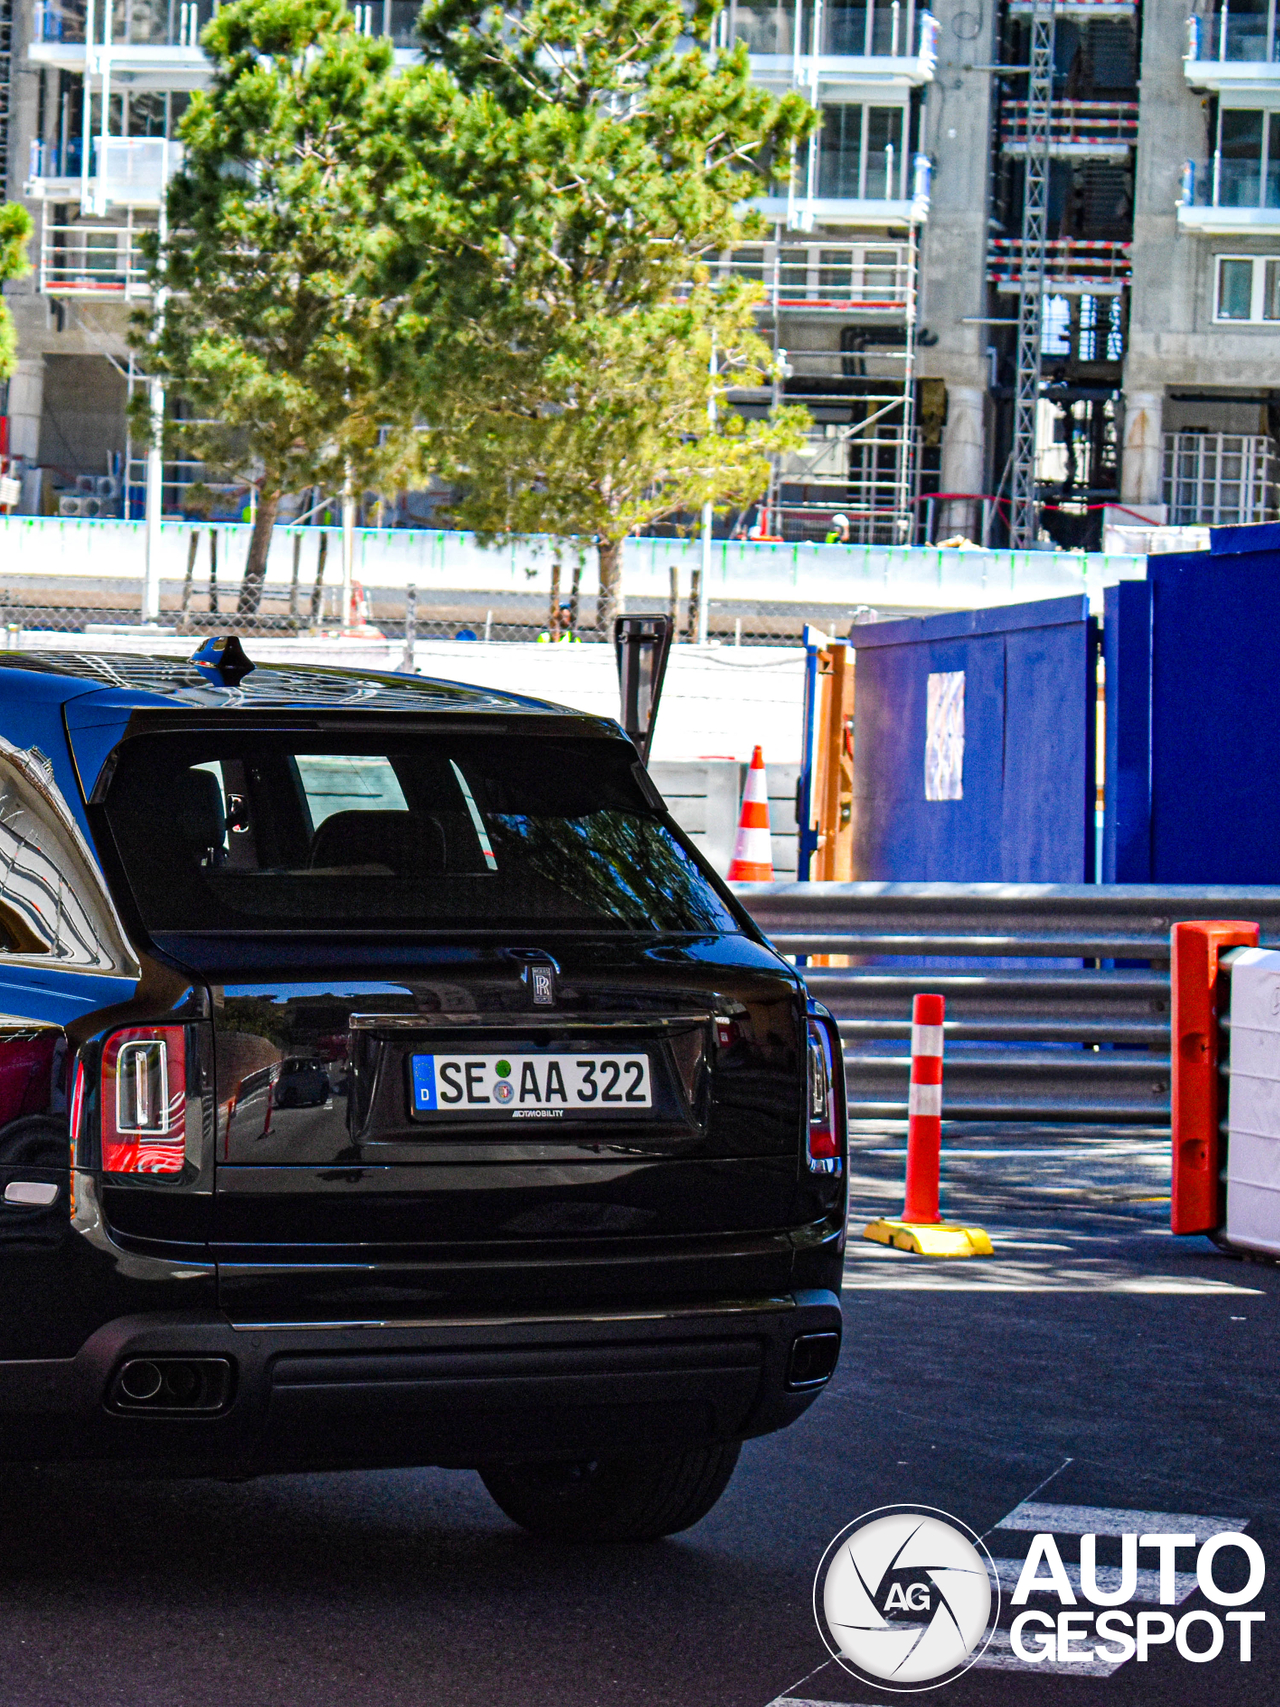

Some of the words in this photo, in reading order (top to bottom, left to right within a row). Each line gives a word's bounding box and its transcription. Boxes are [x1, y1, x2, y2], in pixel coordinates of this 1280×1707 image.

[421, 1088, 429, 1101] D
[439, 1061, 491, 1104] SE
[519, 1061, 568, 1103] AA
[576, 1060, 647, 1103] 322
